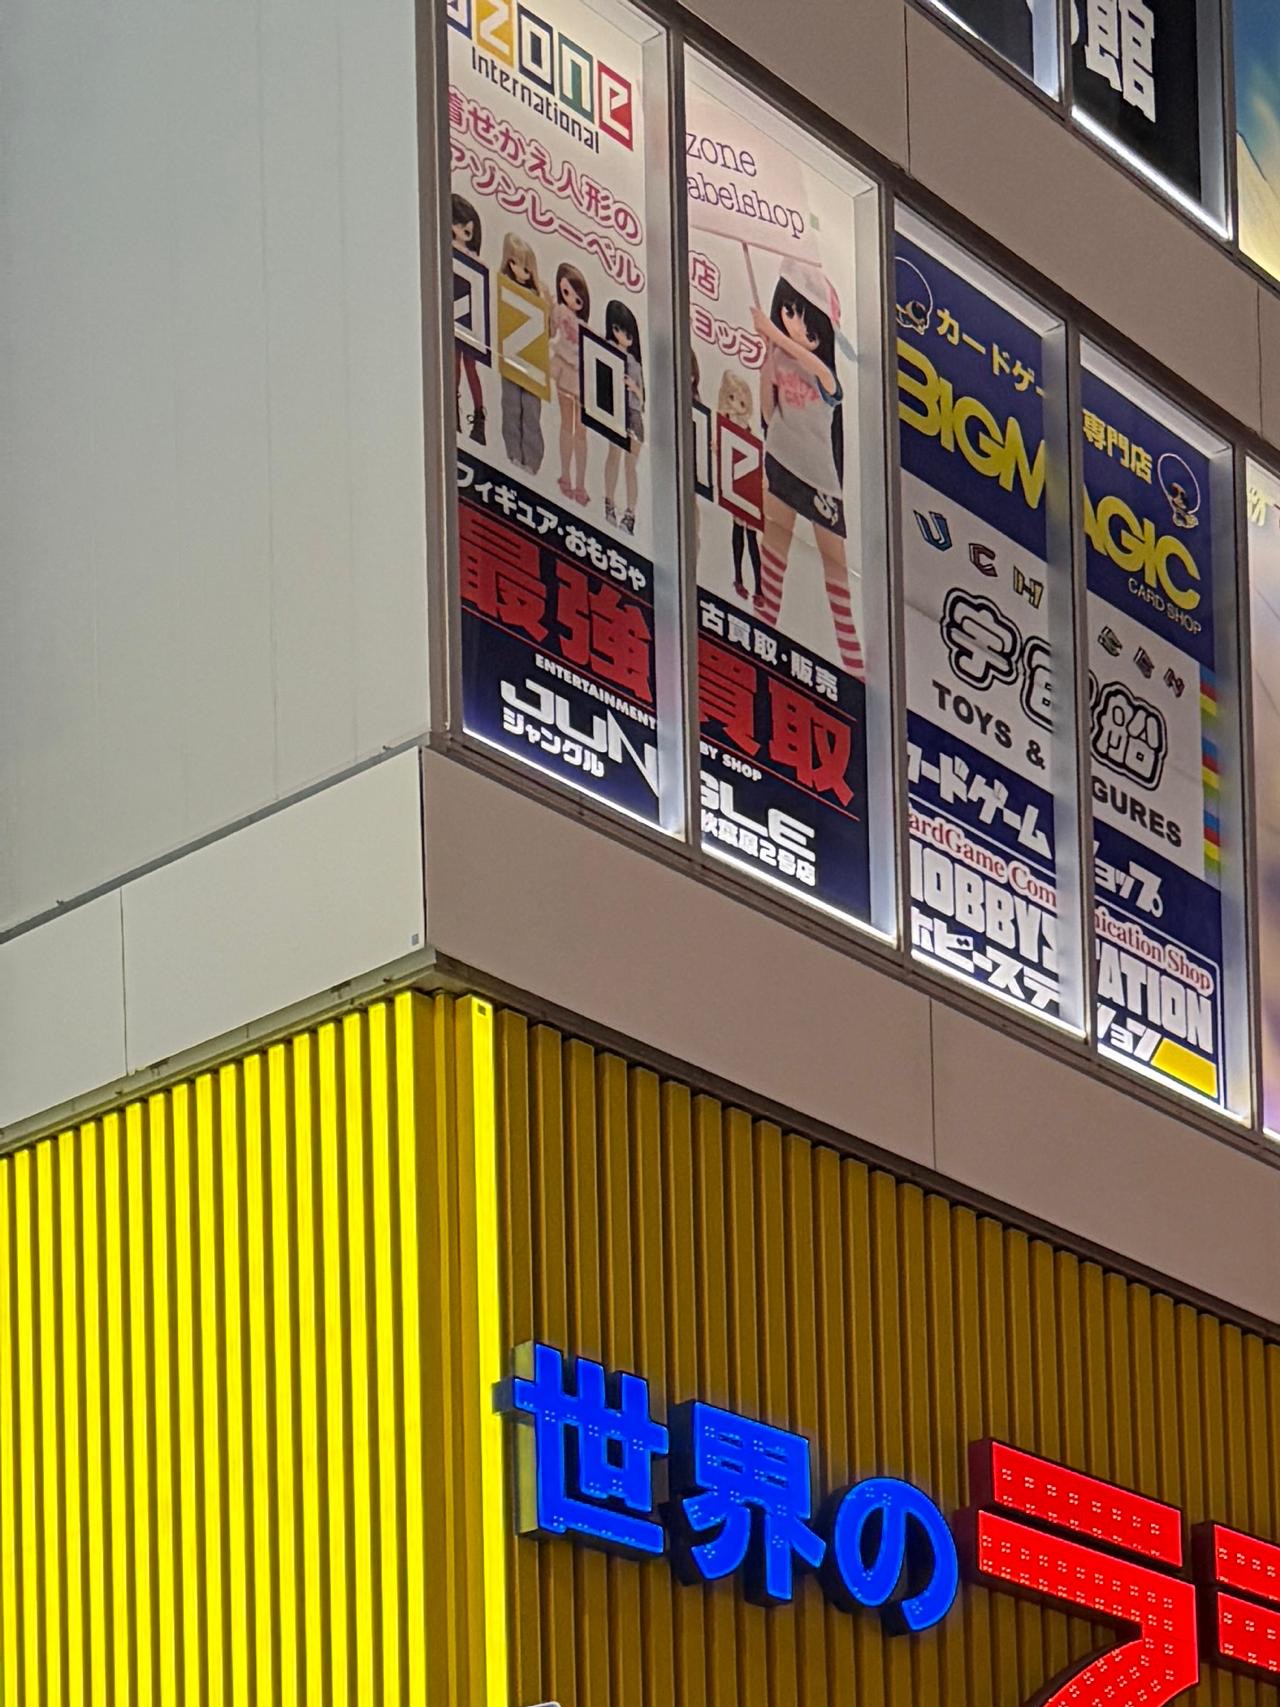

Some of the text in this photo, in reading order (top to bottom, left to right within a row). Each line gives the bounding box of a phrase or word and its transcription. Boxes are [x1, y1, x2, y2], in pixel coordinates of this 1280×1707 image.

[472, 46, 600, 153] International
[685, 131, 758, 178] zone
[687, 173, 805, 239] abelshop
[691, 305, 767, 370] ョップ
[1082, 408, 1153, 485] 専門店
[460, 503, 655, 704] 最強
[1128, 577, 1203, 636] CARD SHOP
[701, 601, 839, 702] 古買取・販売
[535, 652, 658, 731] ENTERTAINMENT
[931, 679, 1047, 771] TOYS &
[502, 707, 605, 779] ジャングル
[722, 752, 763, 783] SHOP
[1094, 840, 1164, 920] ョップ
[1166, 937, 1213, 996] Shop
[494, 1339, 961, 1636] 世界の
